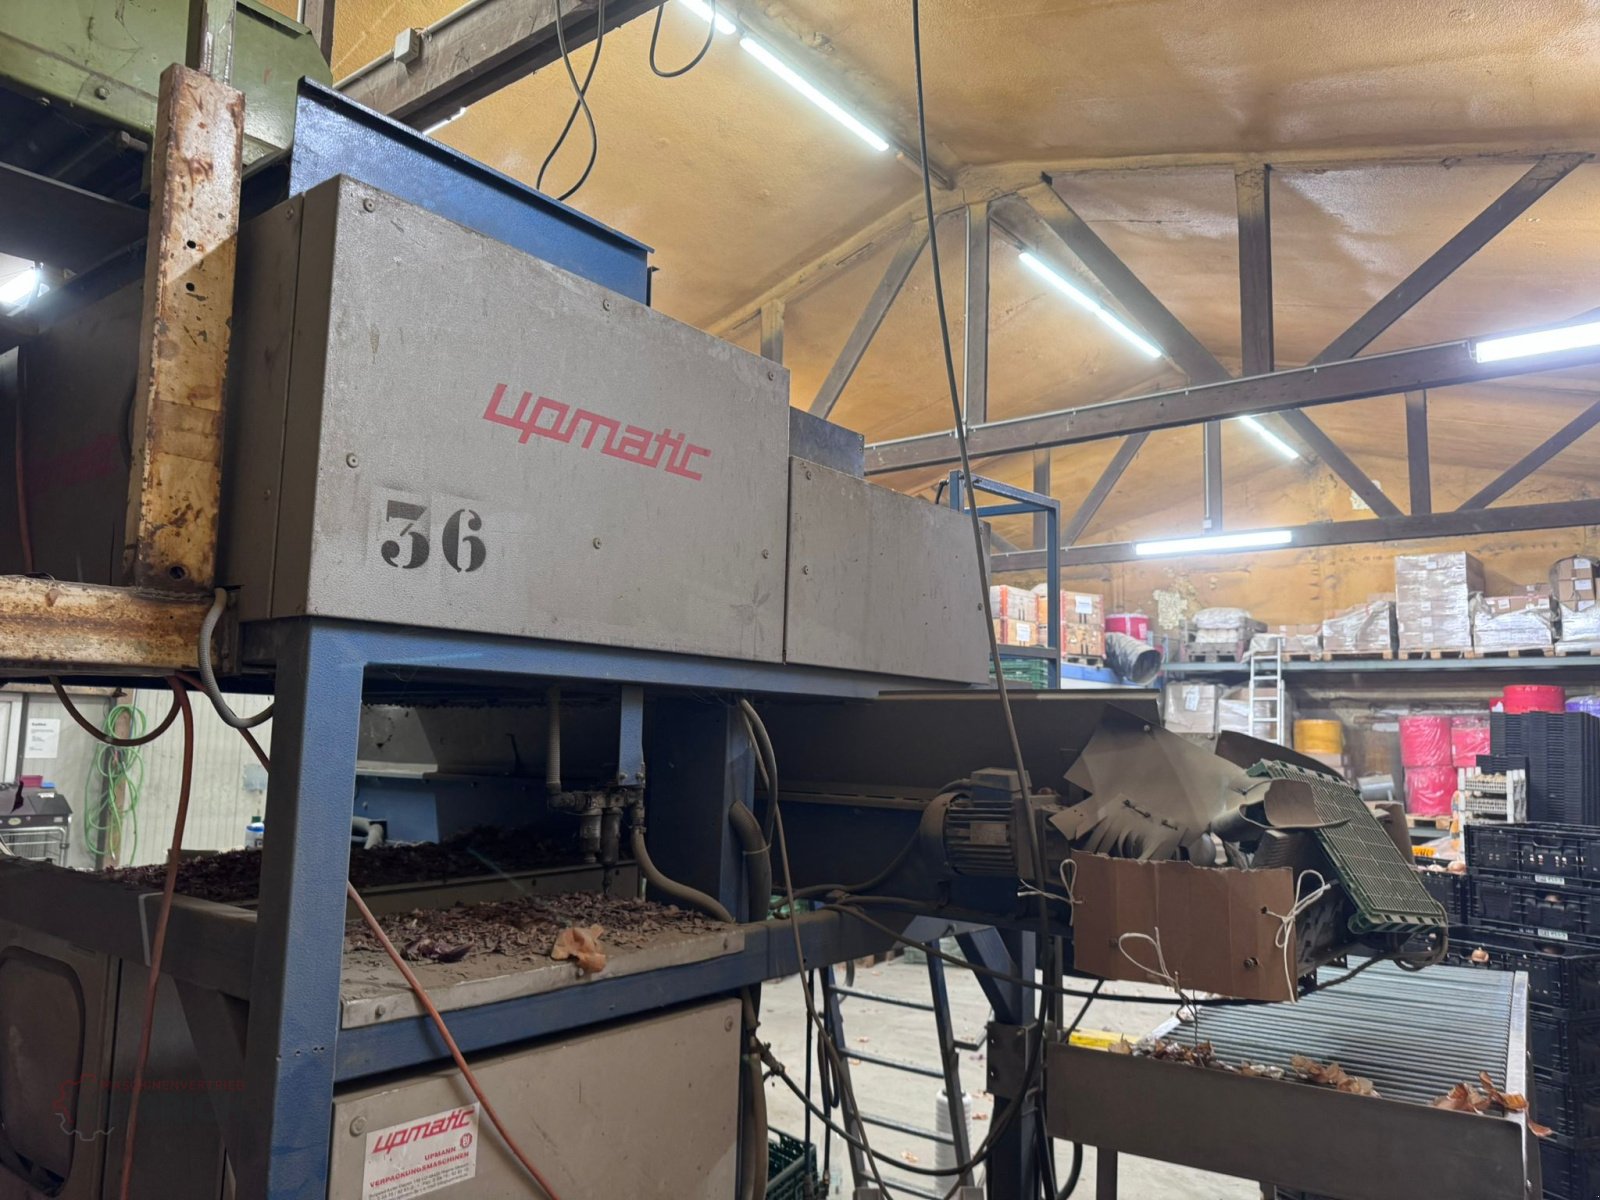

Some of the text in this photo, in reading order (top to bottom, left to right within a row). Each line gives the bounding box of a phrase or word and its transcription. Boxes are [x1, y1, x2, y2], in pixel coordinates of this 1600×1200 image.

[381, 499, 487, 574] 36
[370, 1151, 471, 1188] VERPACKUNGSMASCHINEN
[424, 1146, 457, 1161] UPMANN
